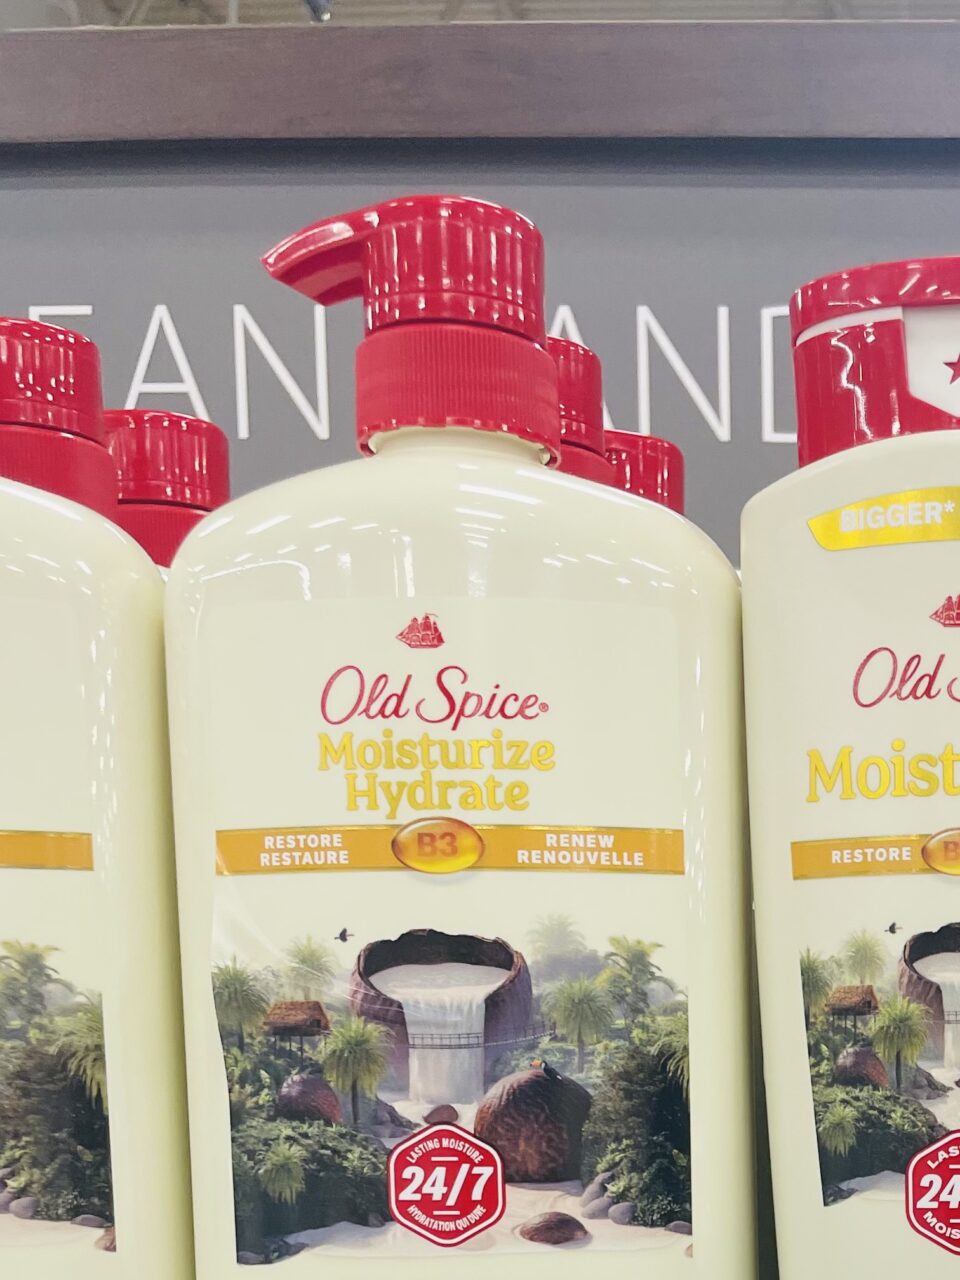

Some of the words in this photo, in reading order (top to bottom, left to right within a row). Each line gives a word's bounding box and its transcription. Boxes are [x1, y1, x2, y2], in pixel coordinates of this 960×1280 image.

[28, 304, 331, 440] AN
[853, 646, 945, 708] Old
[320, 665, 412, 725] Old
[318, 728, 555, 771] Moisturize
[345, 771, 530, 819] Hydrate
[264, 833, 343, 850] RESTORE
[416, 832, 459, 857] B3
[546, 833, 614, 848] RENEW
[260, 850, 349, 866] RESTAURE
[517, 850, 644, 867] RENOUVELLE
[831, 846, 912, 863] RESTORE
[406, 1138, 440, 1163] LASTING
[442, 1137, 484, 1163] MOISTURE
[398, 1163, 494, 1206] 24/7
[407, 1204, 456, 1232] HYDRATATION
